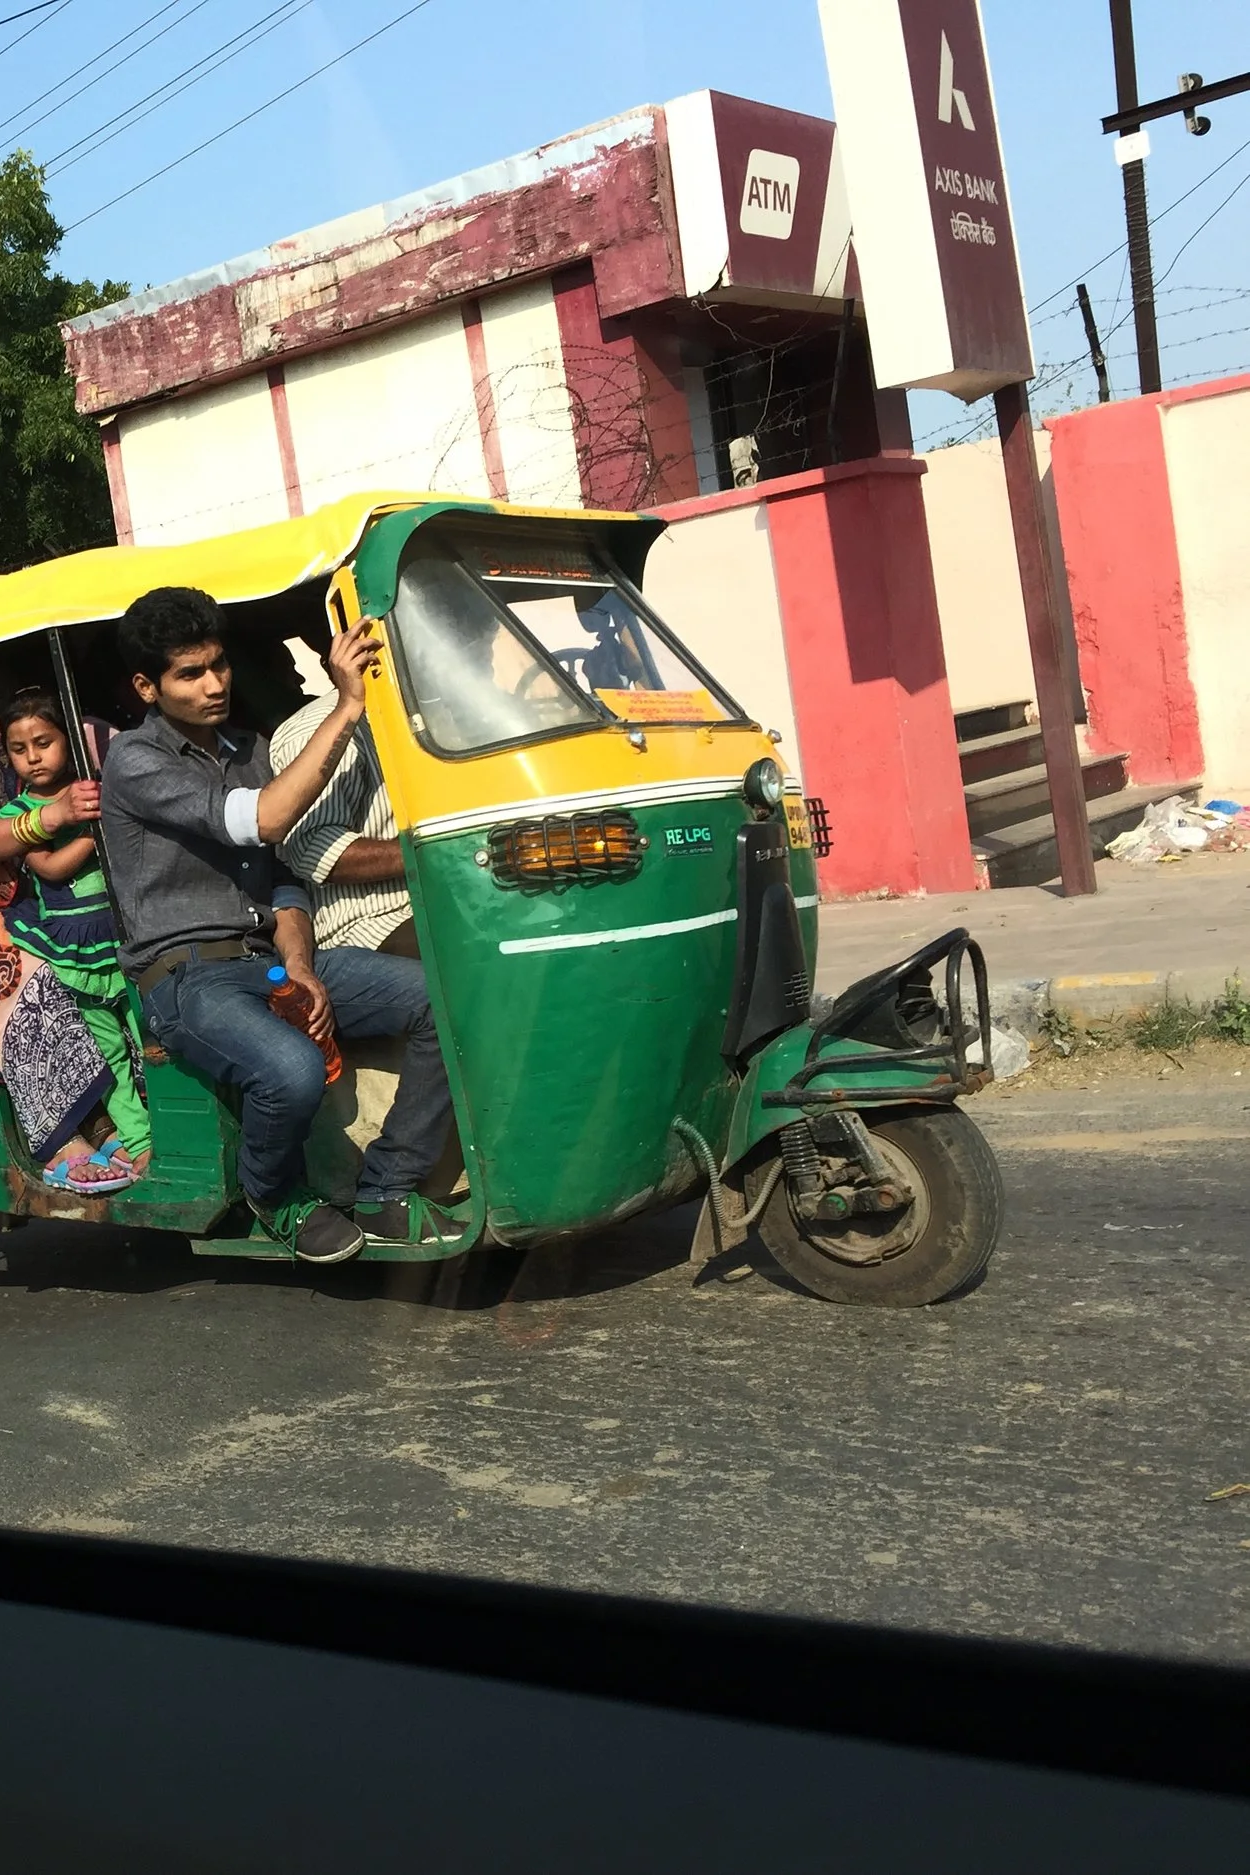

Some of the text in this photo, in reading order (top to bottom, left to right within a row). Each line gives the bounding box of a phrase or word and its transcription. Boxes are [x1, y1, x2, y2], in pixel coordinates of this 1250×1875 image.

[747, 175, 792, 215] ATM
[935, 165, 999, 205] AXIS BANK
[685, 827, 711, 842] LPG
